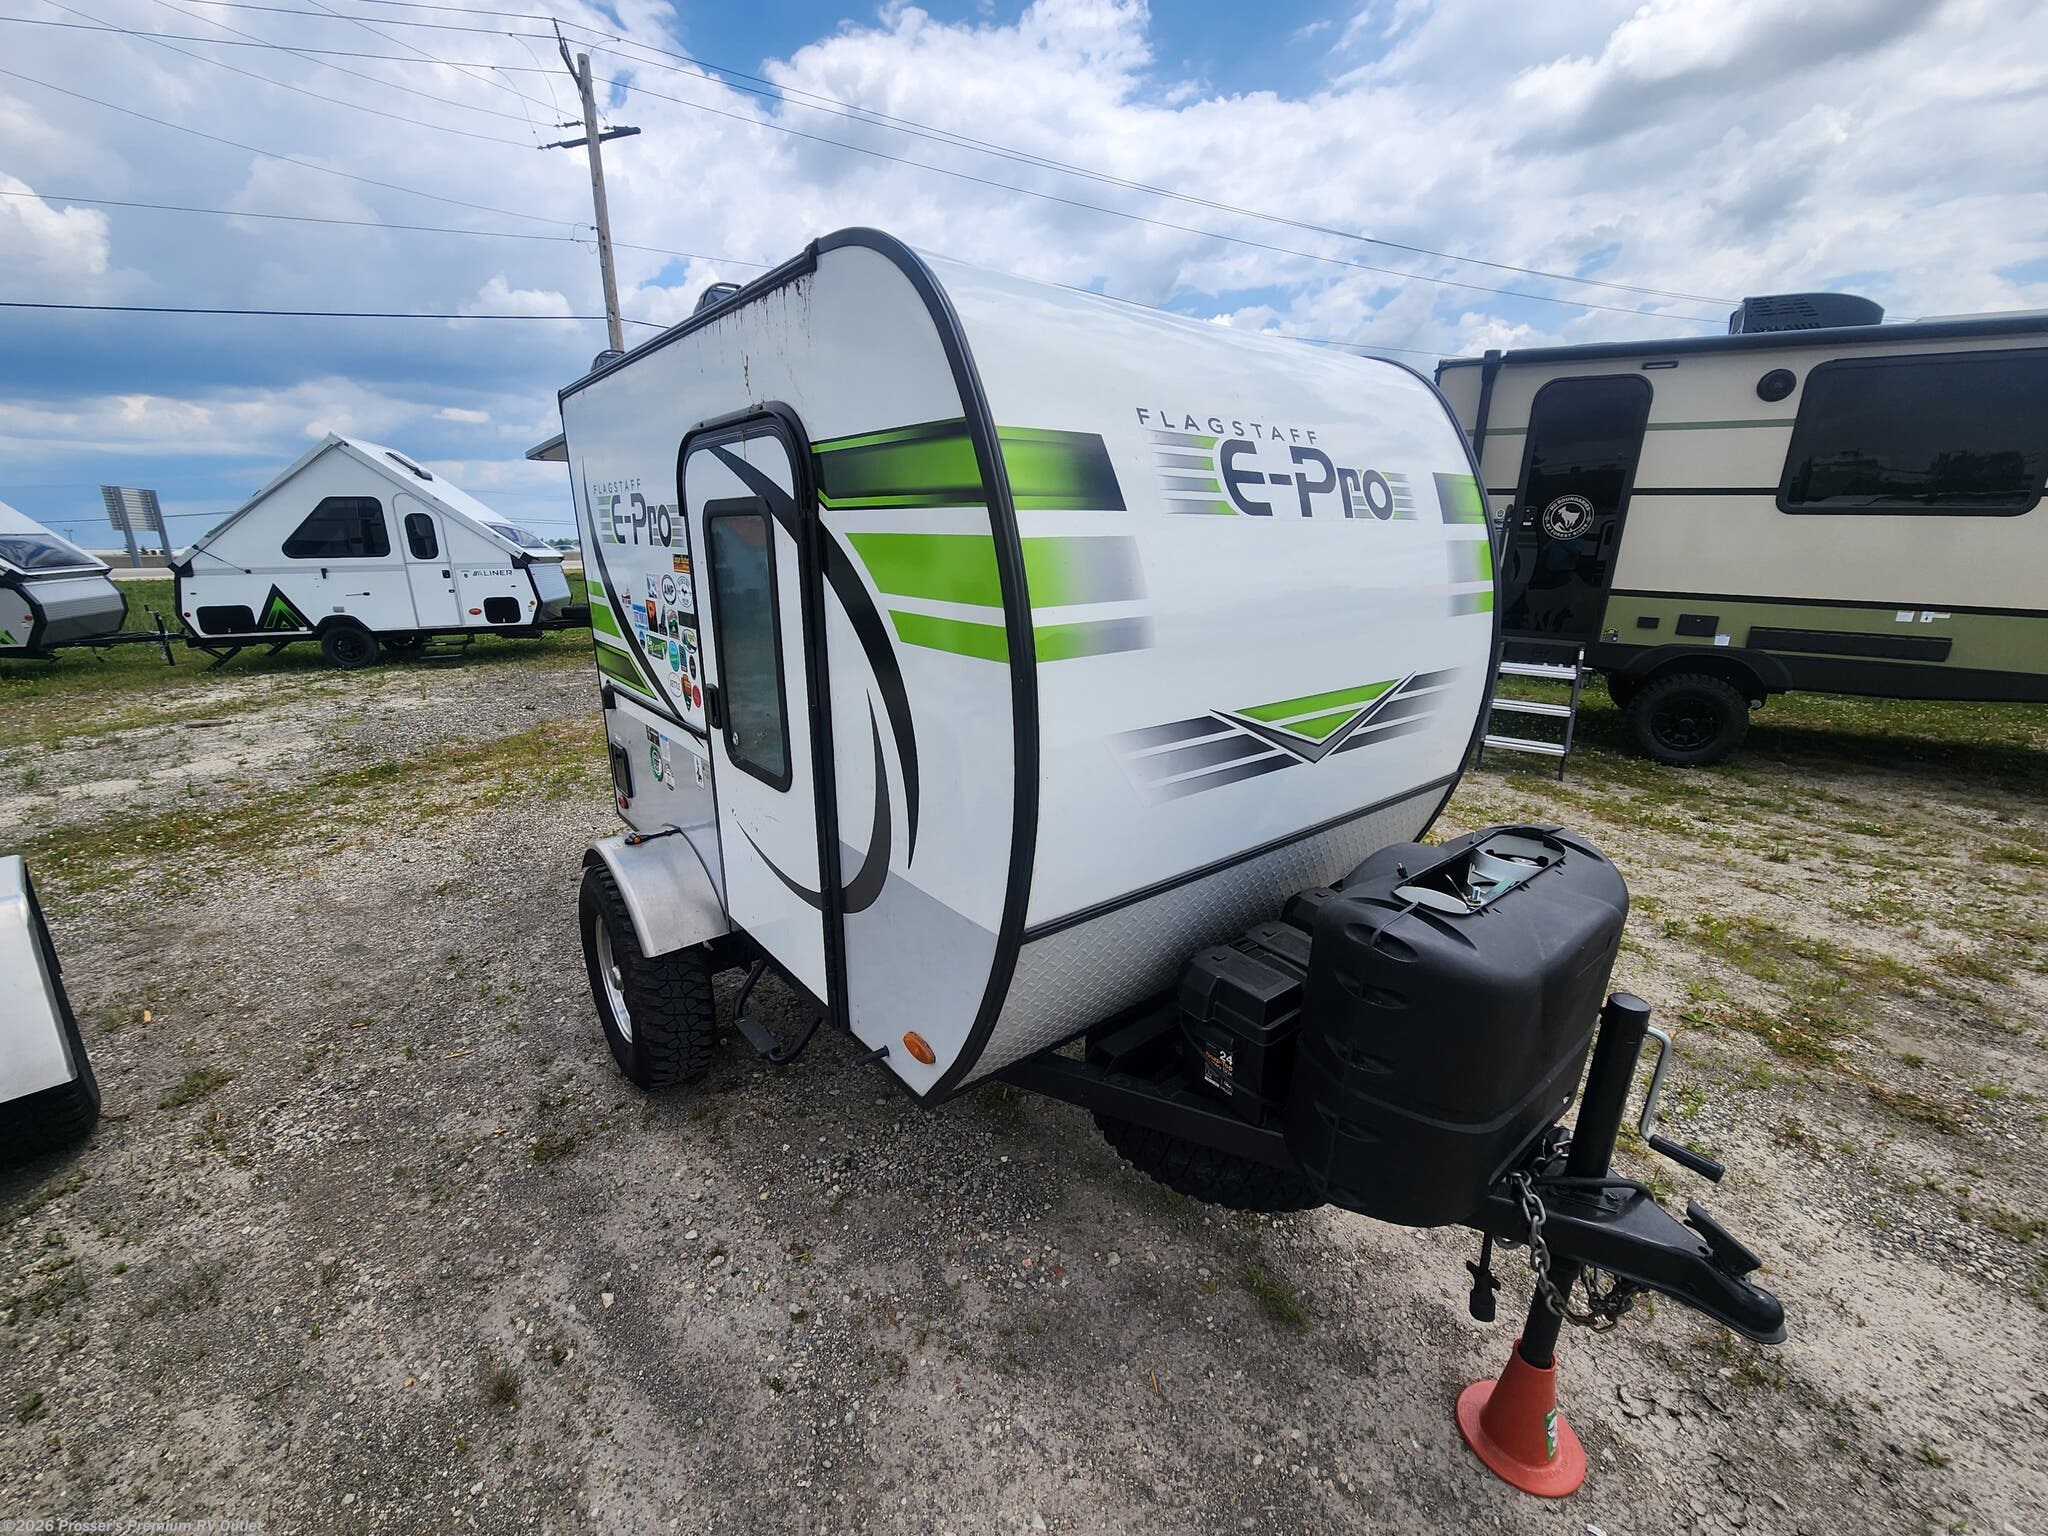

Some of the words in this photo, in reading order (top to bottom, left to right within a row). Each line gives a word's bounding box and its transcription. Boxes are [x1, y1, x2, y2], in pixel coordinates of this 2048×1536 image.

[1136, 407, 1317, 445] FLAGSTAFF
[593, 478, 641, 494] FLAGSTAFF
[1219, 438, 1395, 521] E-Pro
[611, 492, 672, 548] E-Pro
[1219, 1050, 1233, 1066] 24
